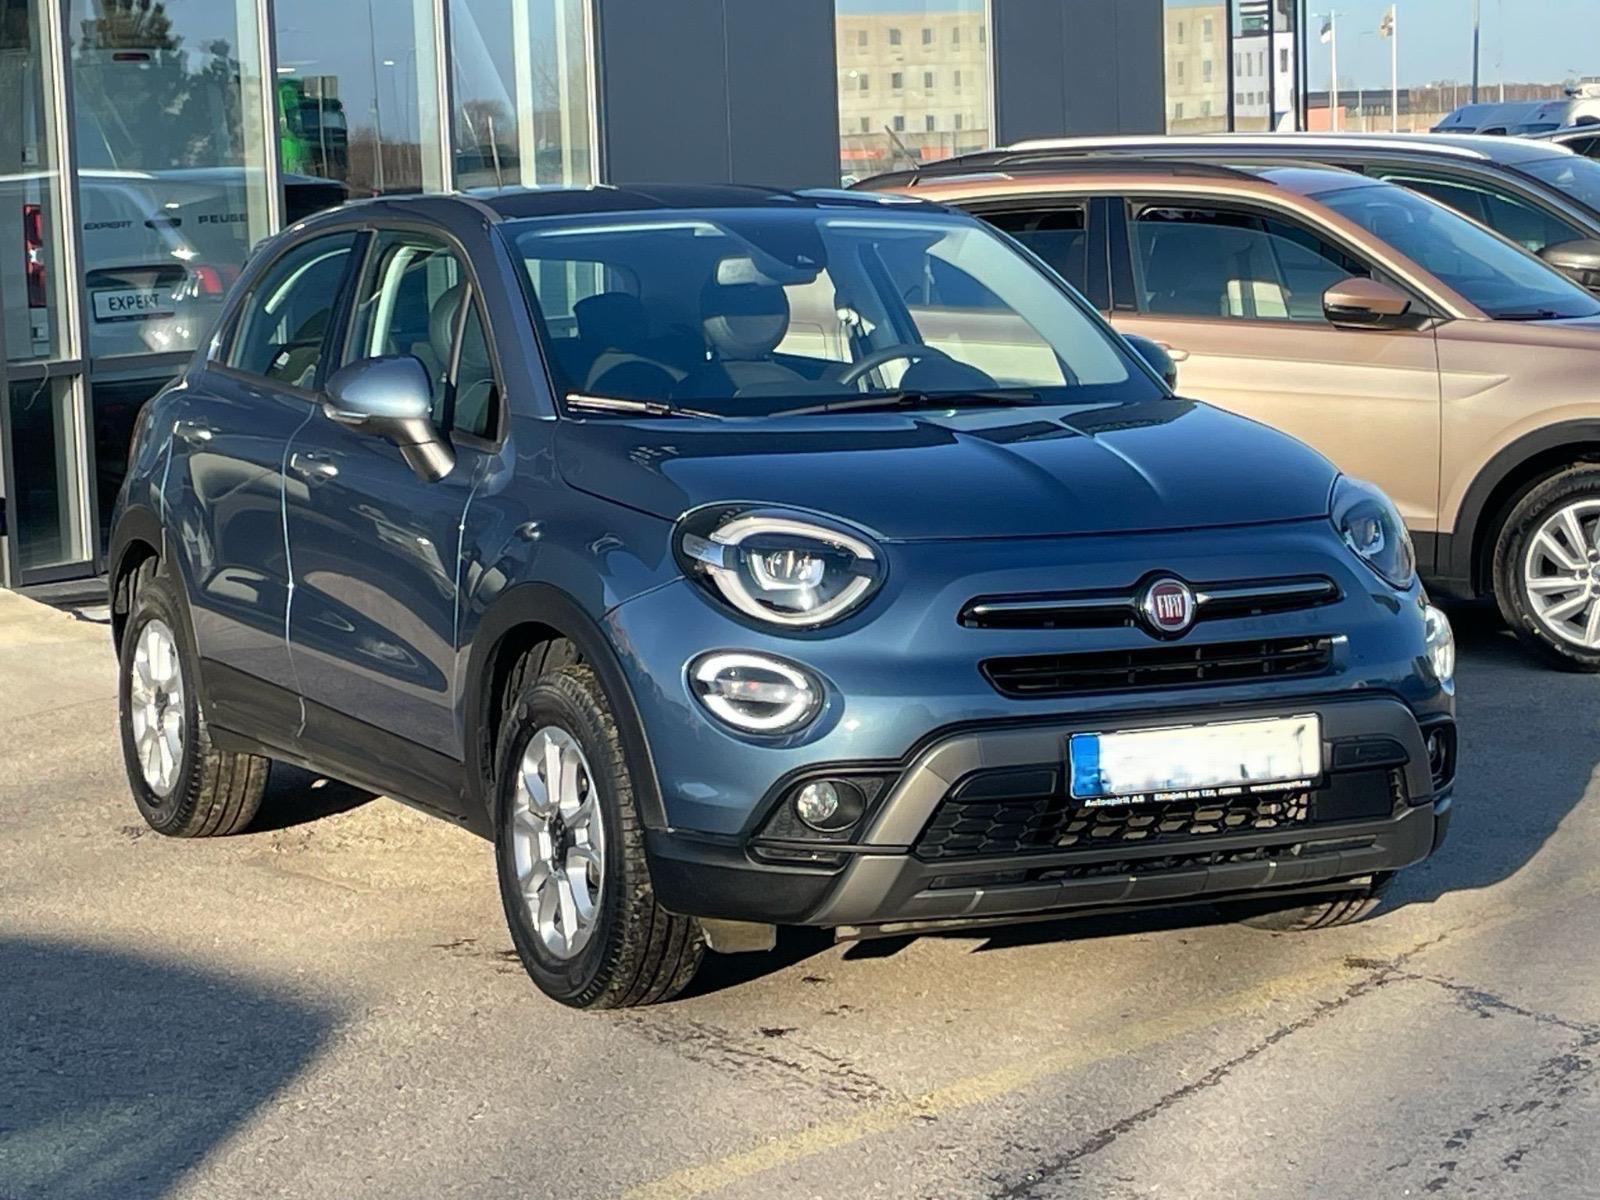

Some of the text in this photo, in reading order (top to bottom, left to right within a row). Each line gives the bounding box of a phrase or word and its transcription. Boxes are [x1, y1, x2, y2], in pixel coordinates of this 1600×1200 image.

[84, 221, 132, 230] EXPERT
[108, 294, 159, 311] EXPERT
[1157, 594, 1183, 618] FIAT
